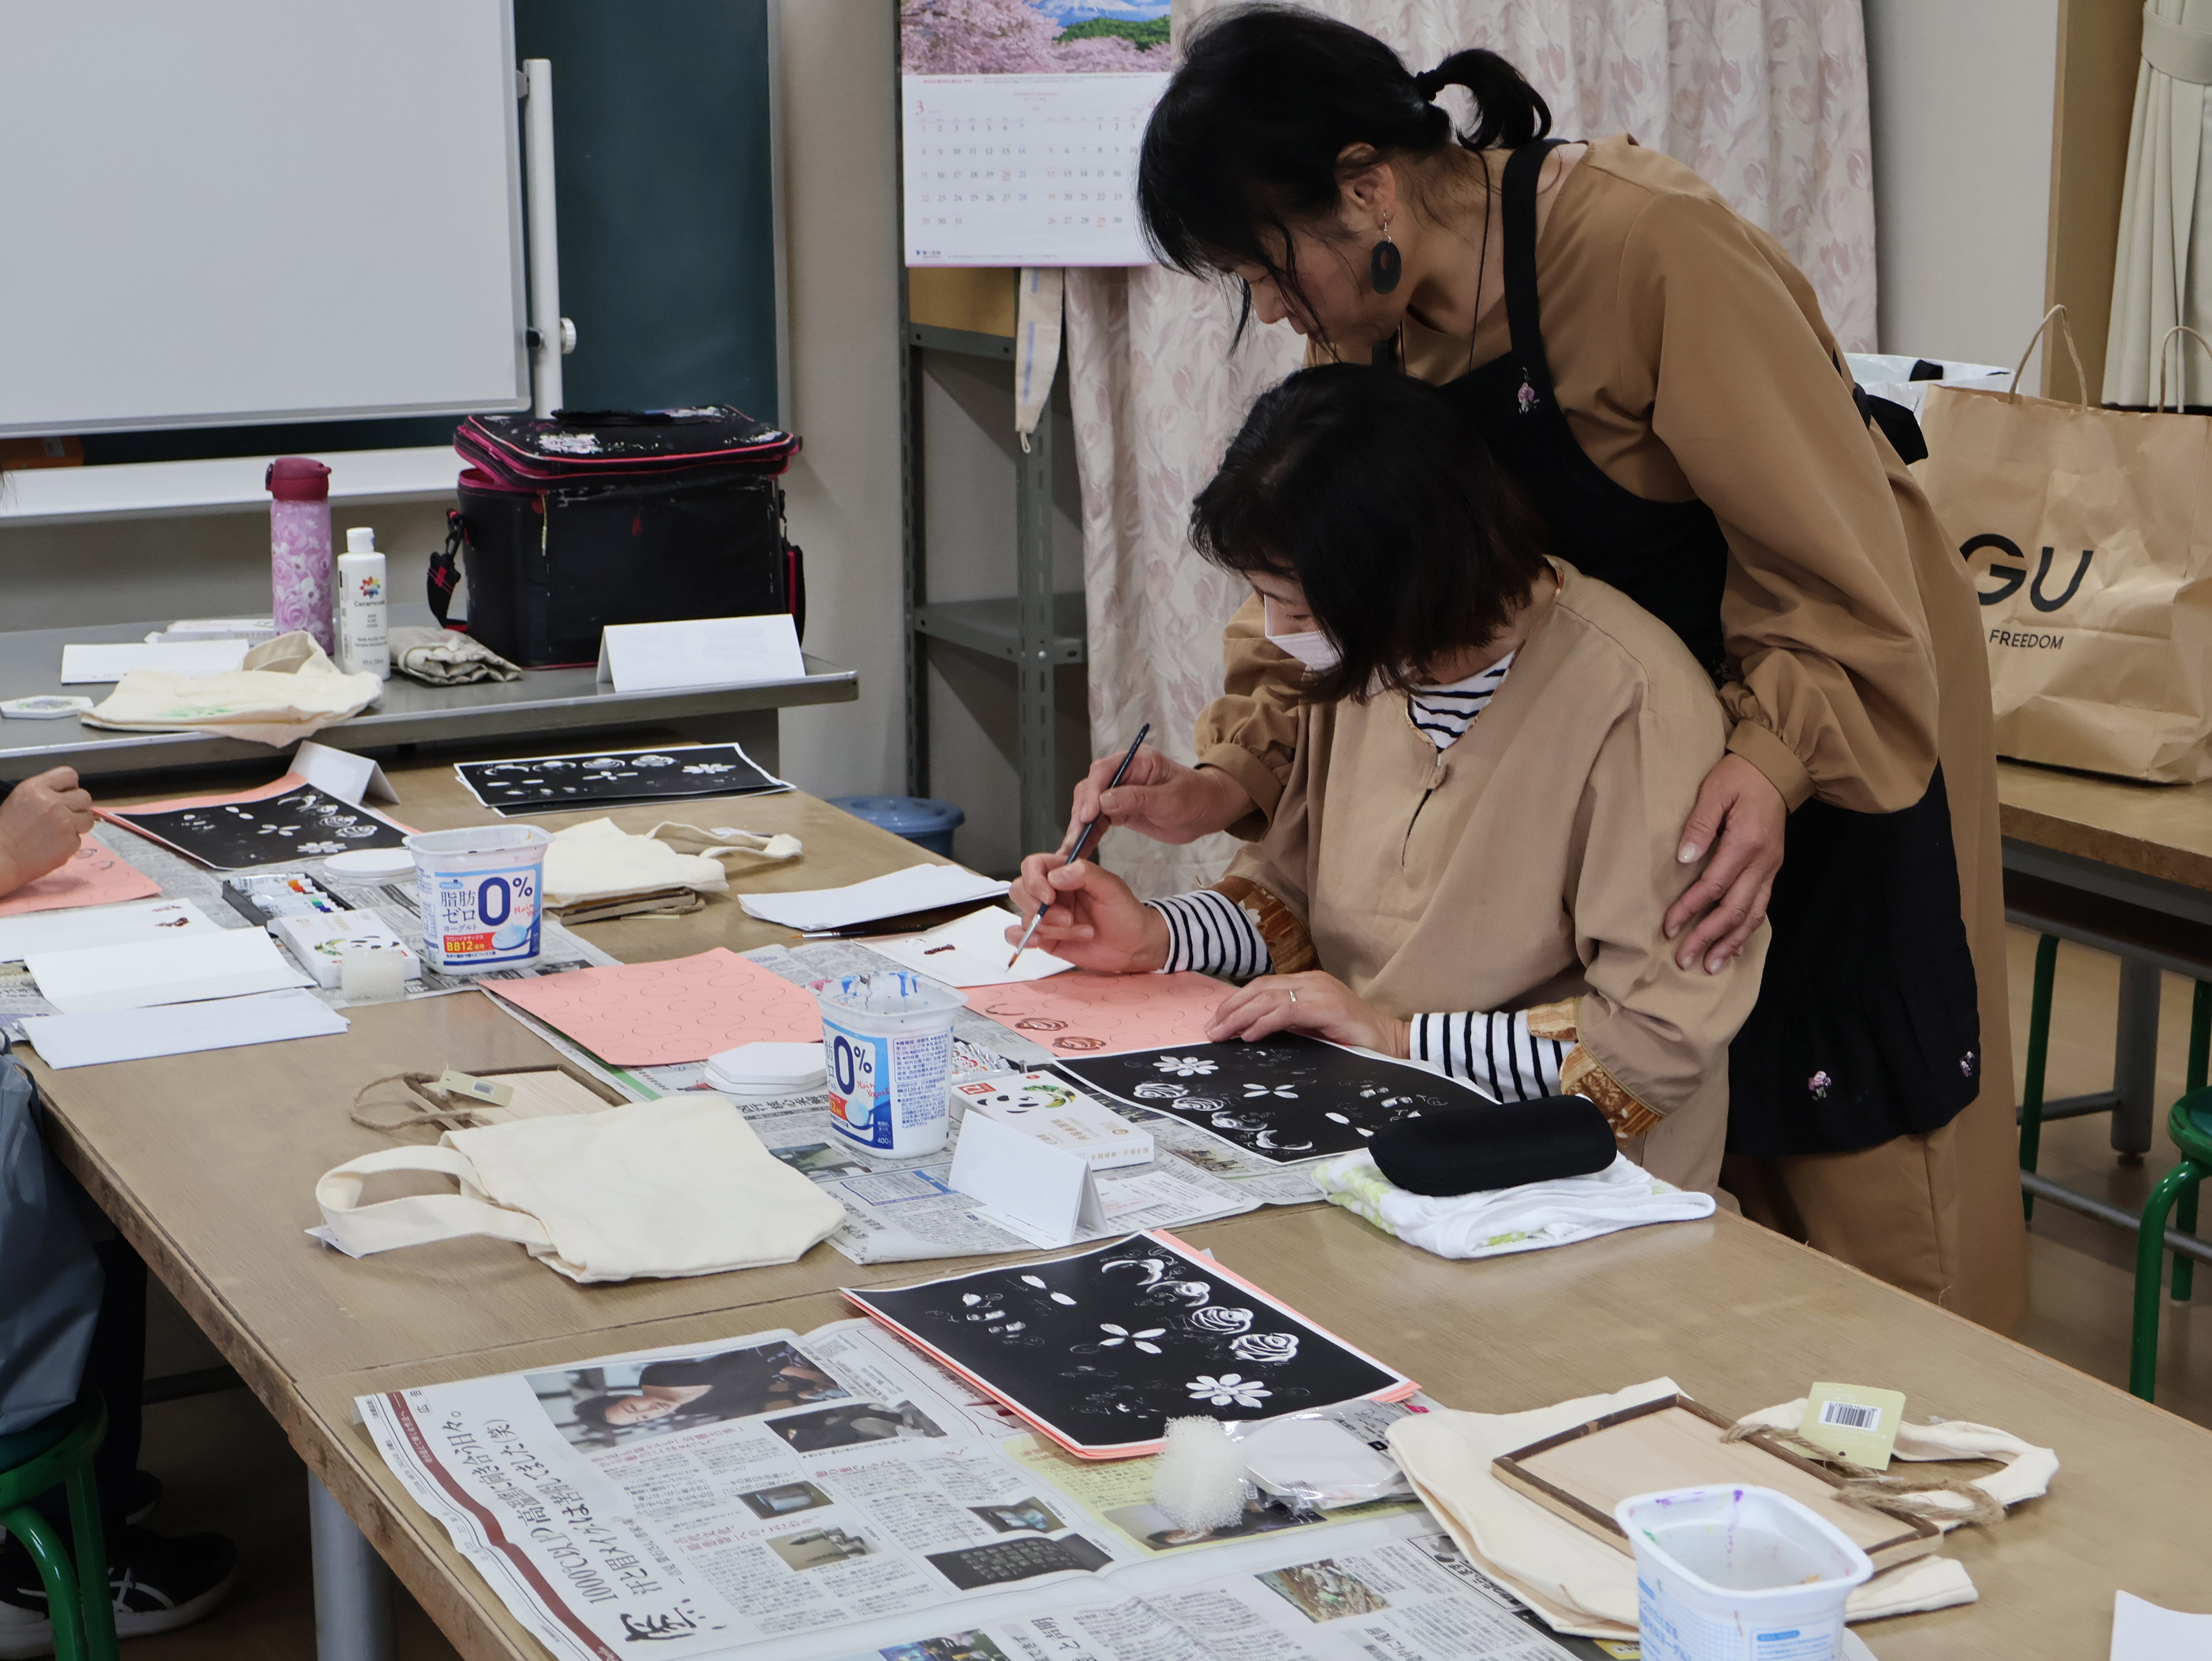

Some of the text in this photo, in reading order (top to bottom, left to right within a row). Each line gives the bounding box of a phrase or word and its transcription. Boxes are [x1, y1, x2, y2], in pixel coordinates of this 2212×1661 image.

[915, 100, 924, 115] 3
[985, 147, 993, 155] 12
[954, 171, 962, 179] 17
[1002, 170, 1012, 179] 20
[1019, 169, 1026, 178] 21
[1047, 170, 1056, 178] 12
[1097, 169, 1105, 178] 15
[937, 194, 947, 202] 23
[970, 194, 979, 202] 25
[986, 194, 995, 202] 26
[1002, 194, 1011, 202] 27
[1064, 193, 1073, 201] 20
[1080, 193, 1088, 201] 21
[1097, 193, 1106, 201] 22
[1113, 193, 1123, 201] 23
[921, 217, 931, 225] 29
[1047, 217, 1057, 225] 26
[1064, 216, 1073, 225] 27
[1959, 534, 2093, 612] GU
[1989, 629, 2064, 650] FREEDOM
[440, 890, 476, 908] 脂肪
[478, 877, 533, 926] 0%
[442, 908, 475, 924] ゼロ
[444, 924, 477, 933] ヨーグルト
[834, 1035, 872, 1095] 0%
[857, 1080, 875, 1089] Plain
